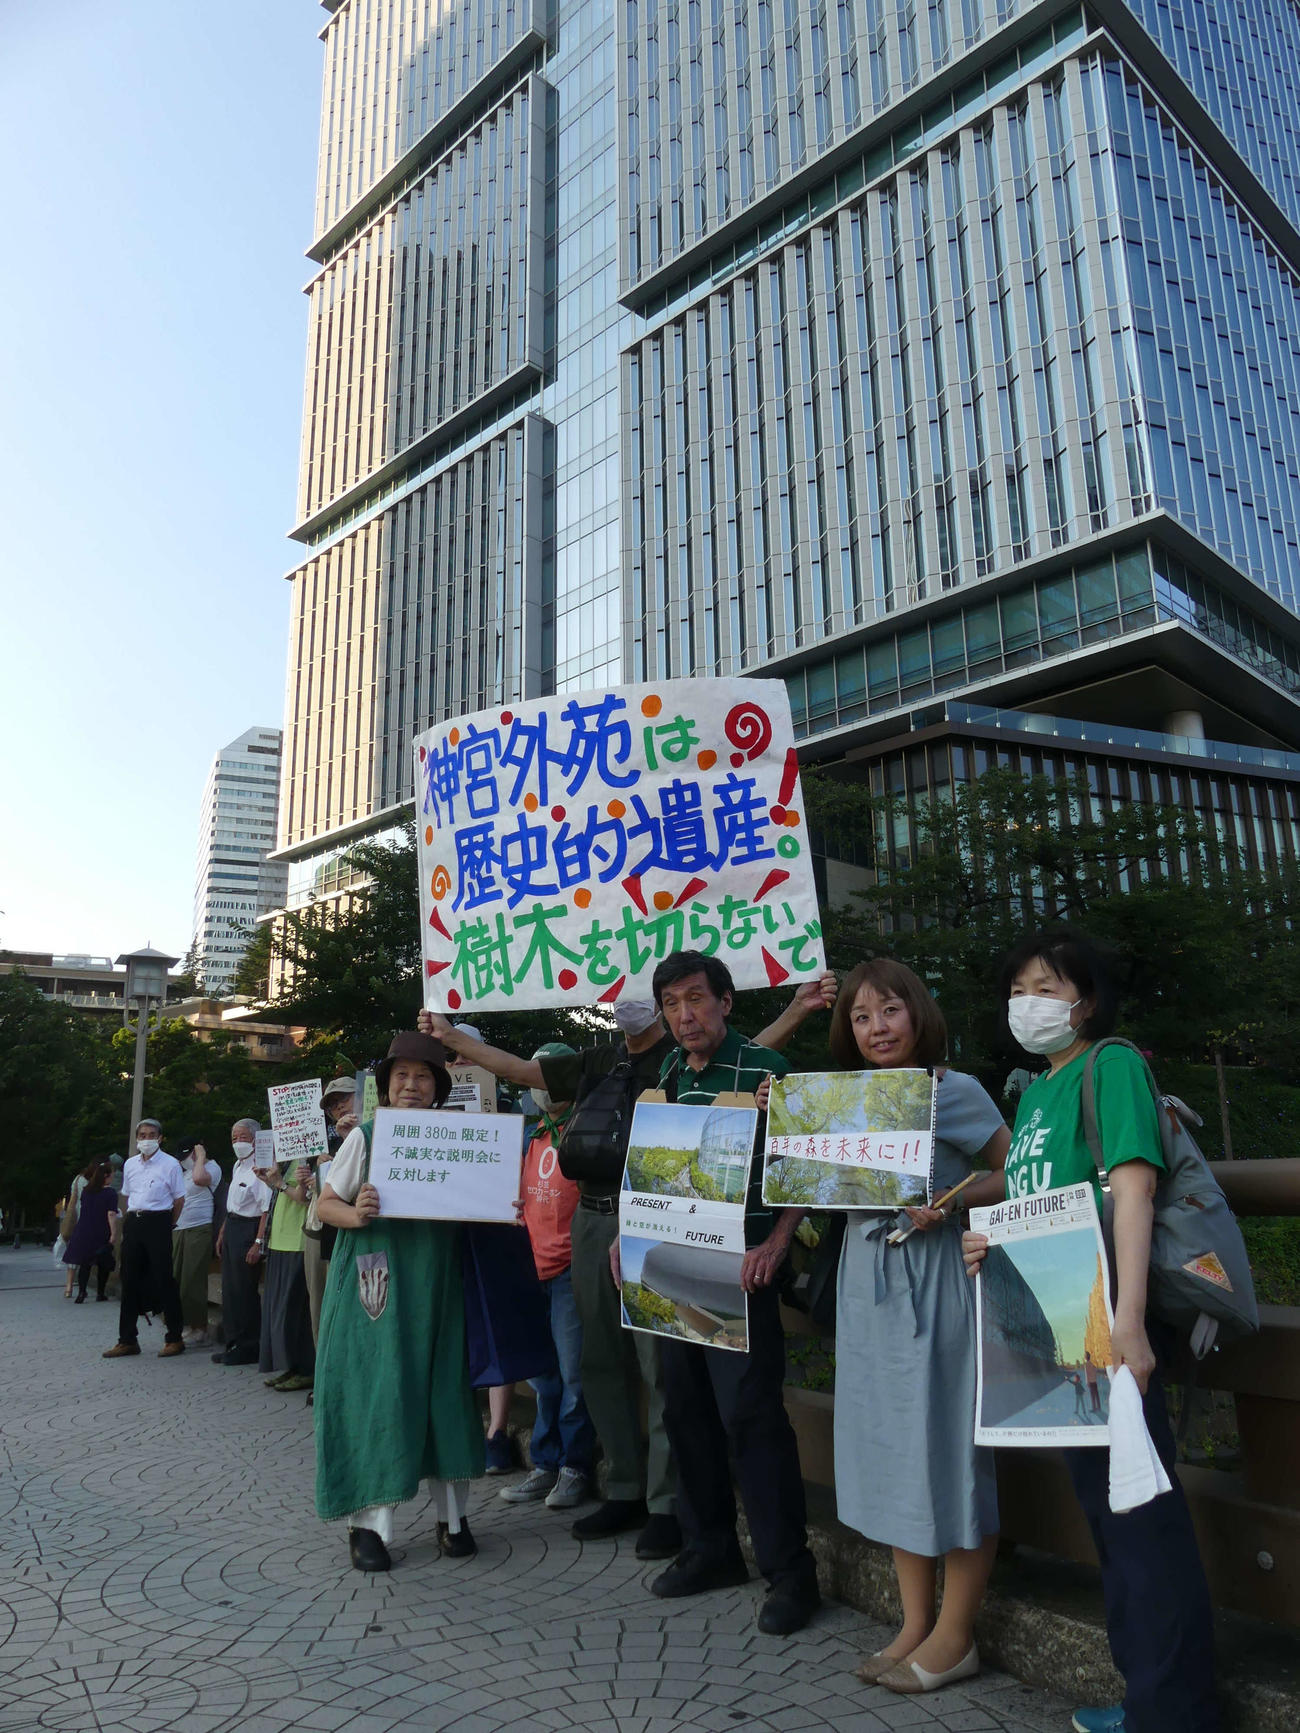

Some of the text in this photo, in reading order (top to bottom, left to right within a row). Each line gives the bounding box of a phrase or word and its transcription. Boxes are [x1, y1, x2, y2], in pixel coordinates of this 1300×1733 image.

[423, 694, 699, 828] 神宮外苑は
[451, 895, 822, 1000] 樹木を切らないで
[391, 1146, 501, 1163] 不誠実な説明会に
[770, 1137, 920, 1164] 百年の森を未来に!!
[388, 1167, 450, 1183] 反対します
[631, 1197, 697, 1213] PRESENT &
[989, 1203, 1021, 1226] GAI-EN
[1024, 1193, 1066, 1217] FUTURE
[685, 1231, 725, 1244] FUTURE
